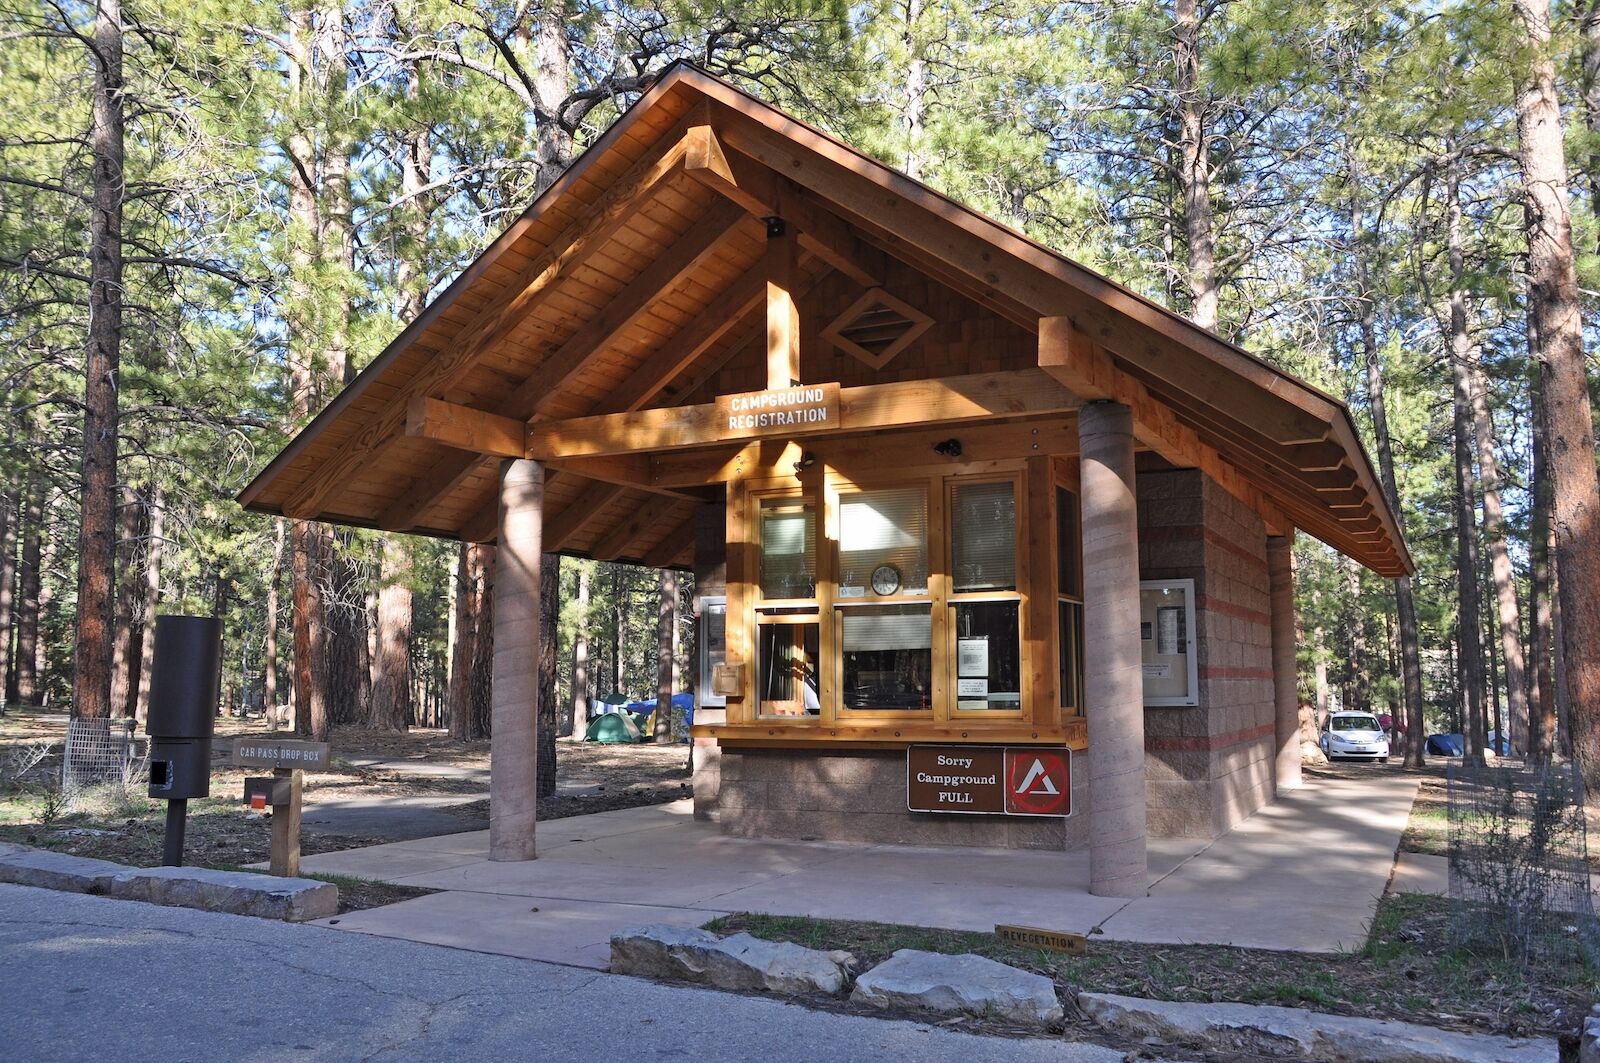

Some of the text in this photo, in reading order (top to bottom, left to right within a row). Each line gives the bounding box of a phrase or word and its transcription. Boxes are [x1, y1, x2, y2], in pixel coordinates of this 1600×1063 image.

[731, 389, 824, 411] CAMPGROUND
[729, 407, 827, 430] REGISTRATION
[240, 747, 319, 761] CAR PASS DROP BOX
[937, 755, 973, 769] Sorry
[917, 772, 996, 786] Campground
[938, 792, 973, 803] FULL
[1002, 930, 1075, 949] REVEGETATION
